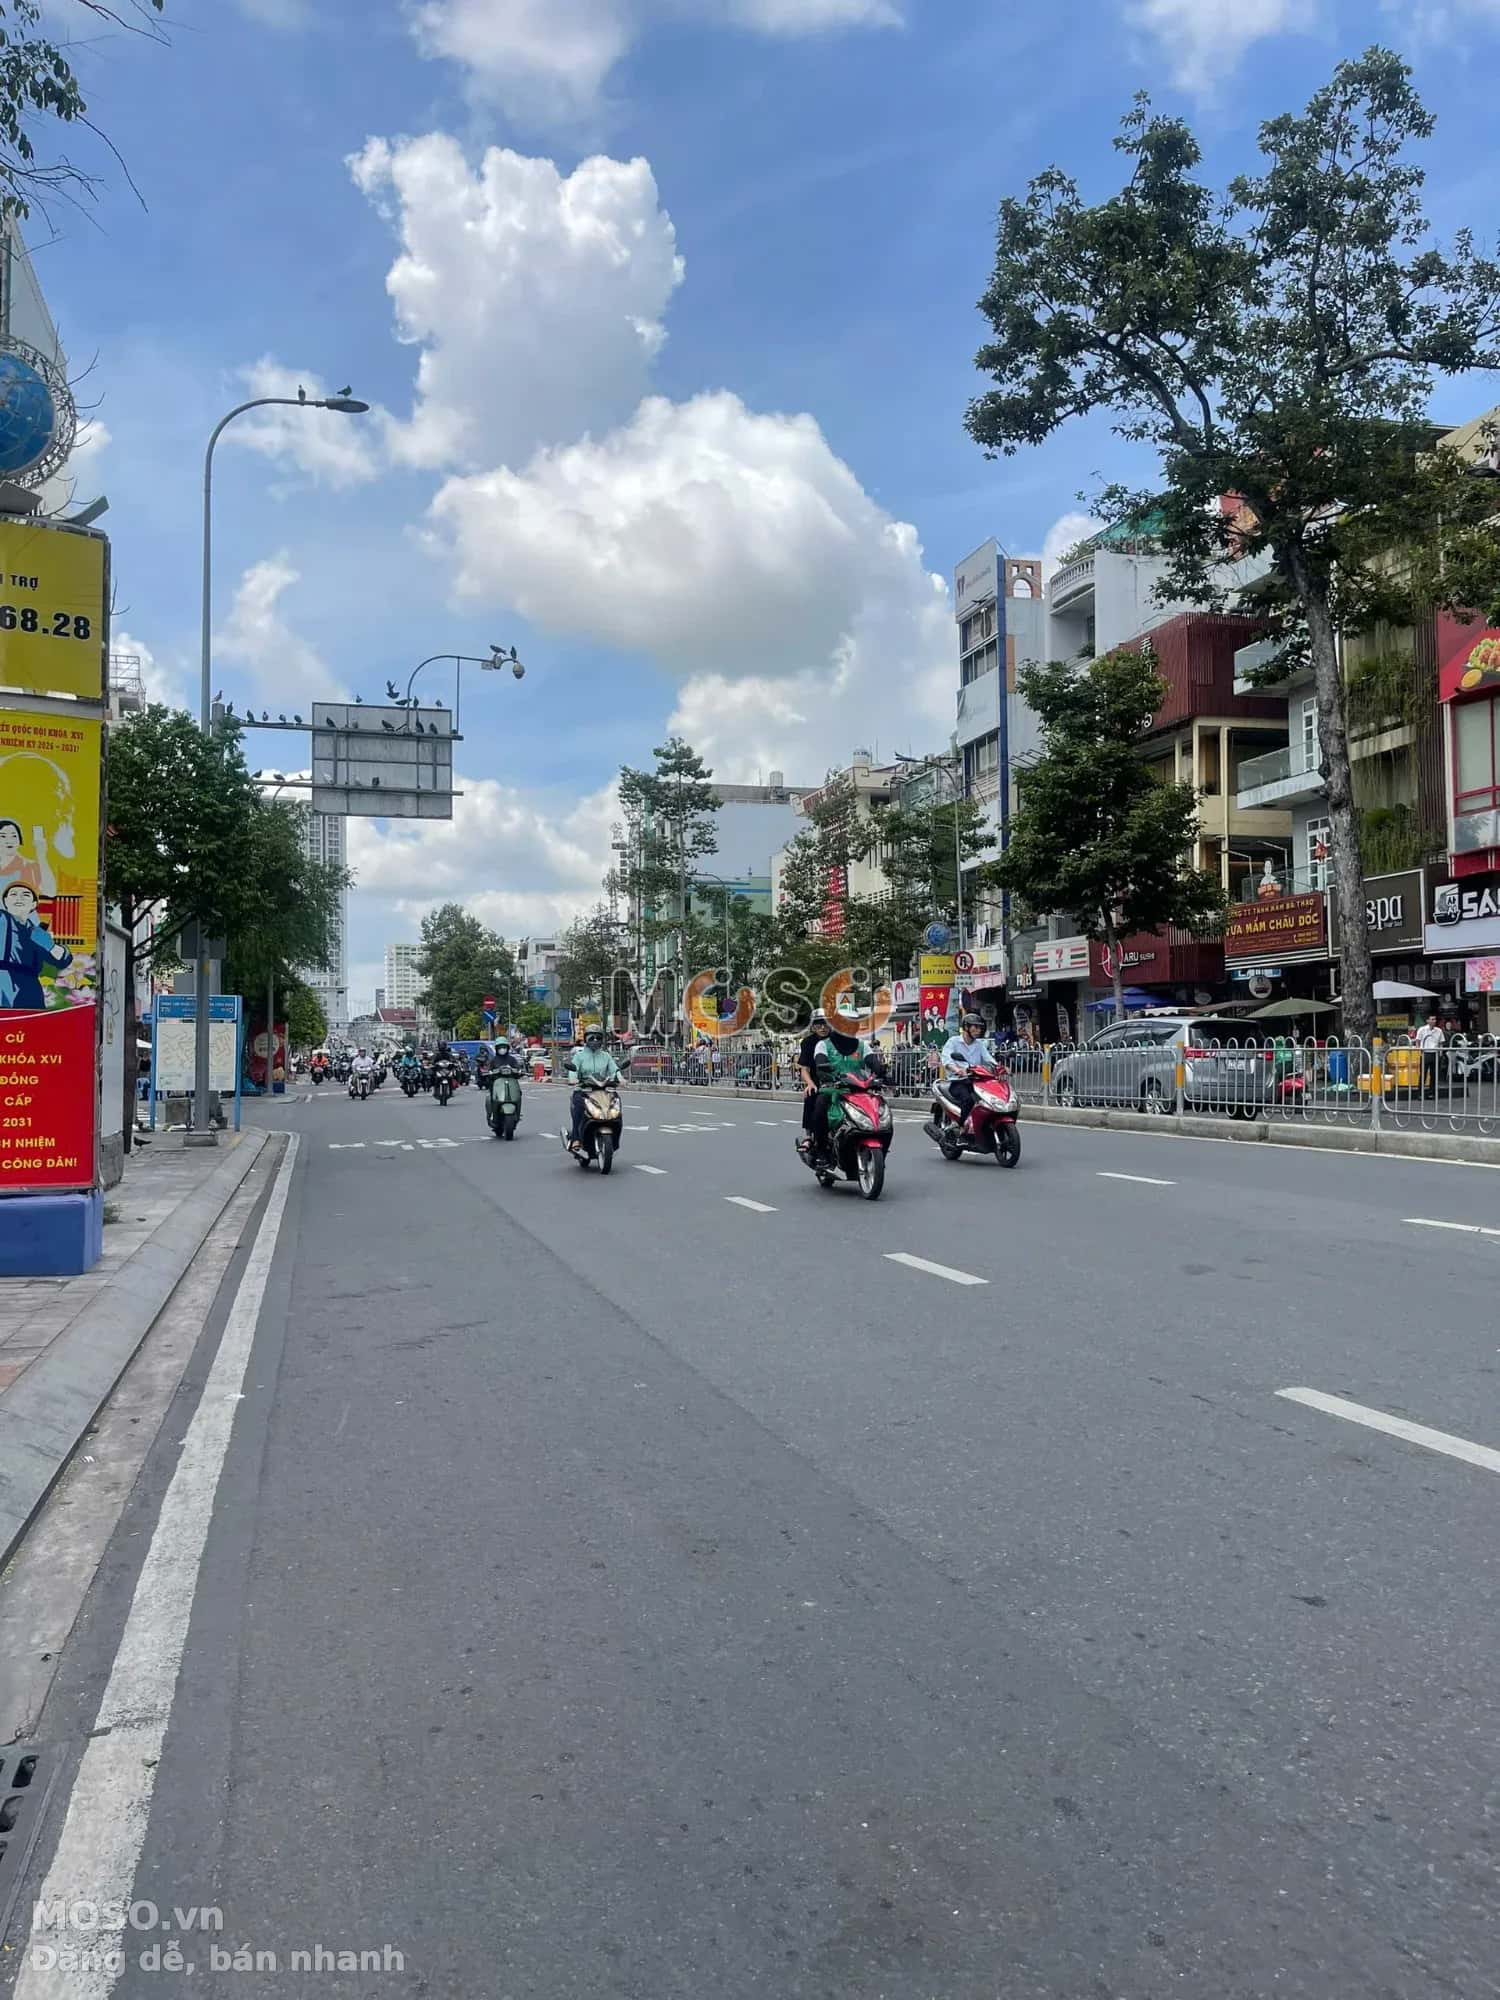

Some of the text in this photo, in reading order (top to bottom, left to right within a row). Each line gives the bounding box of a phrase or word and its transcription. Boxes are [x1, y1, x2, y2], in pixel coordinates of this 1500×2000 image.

[10, 575, 39, 591] TRỢ
[1269, 914, 1295, 930] CHÂU
[1299, 908, 1319, 927] ĐỐC
[5, 1030, 25, 1043] CỬ
[0, 1052, 62, 1064] KHÓA XVI
[4, 1092, 32, 1106] CẤP
[2, 1117, 32, 1128] 2031
[15, 1135, 56, 1150] NHIỆM
[2, 1155, 78, 1169] CÔNG DÂN!
